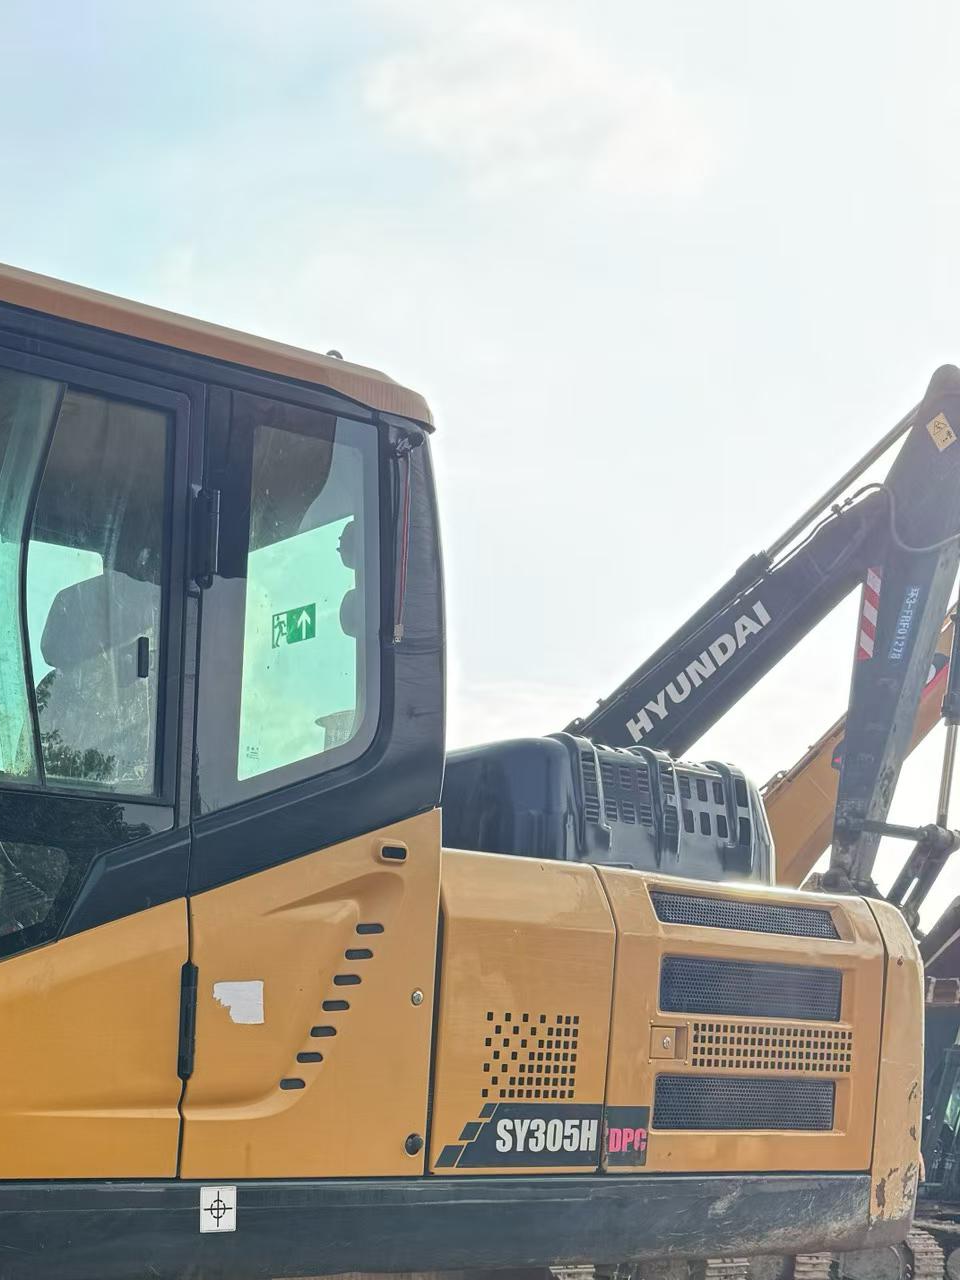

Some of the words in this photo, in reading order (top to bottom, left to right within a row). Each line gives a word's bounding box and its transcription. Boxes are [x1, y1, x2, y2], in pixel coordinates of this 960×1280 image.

[626, 600, 771, 743] HYUNDAI
[495, 1118, 599, 1153] SY305H
[608, 1127, 648, 1153] DPC
